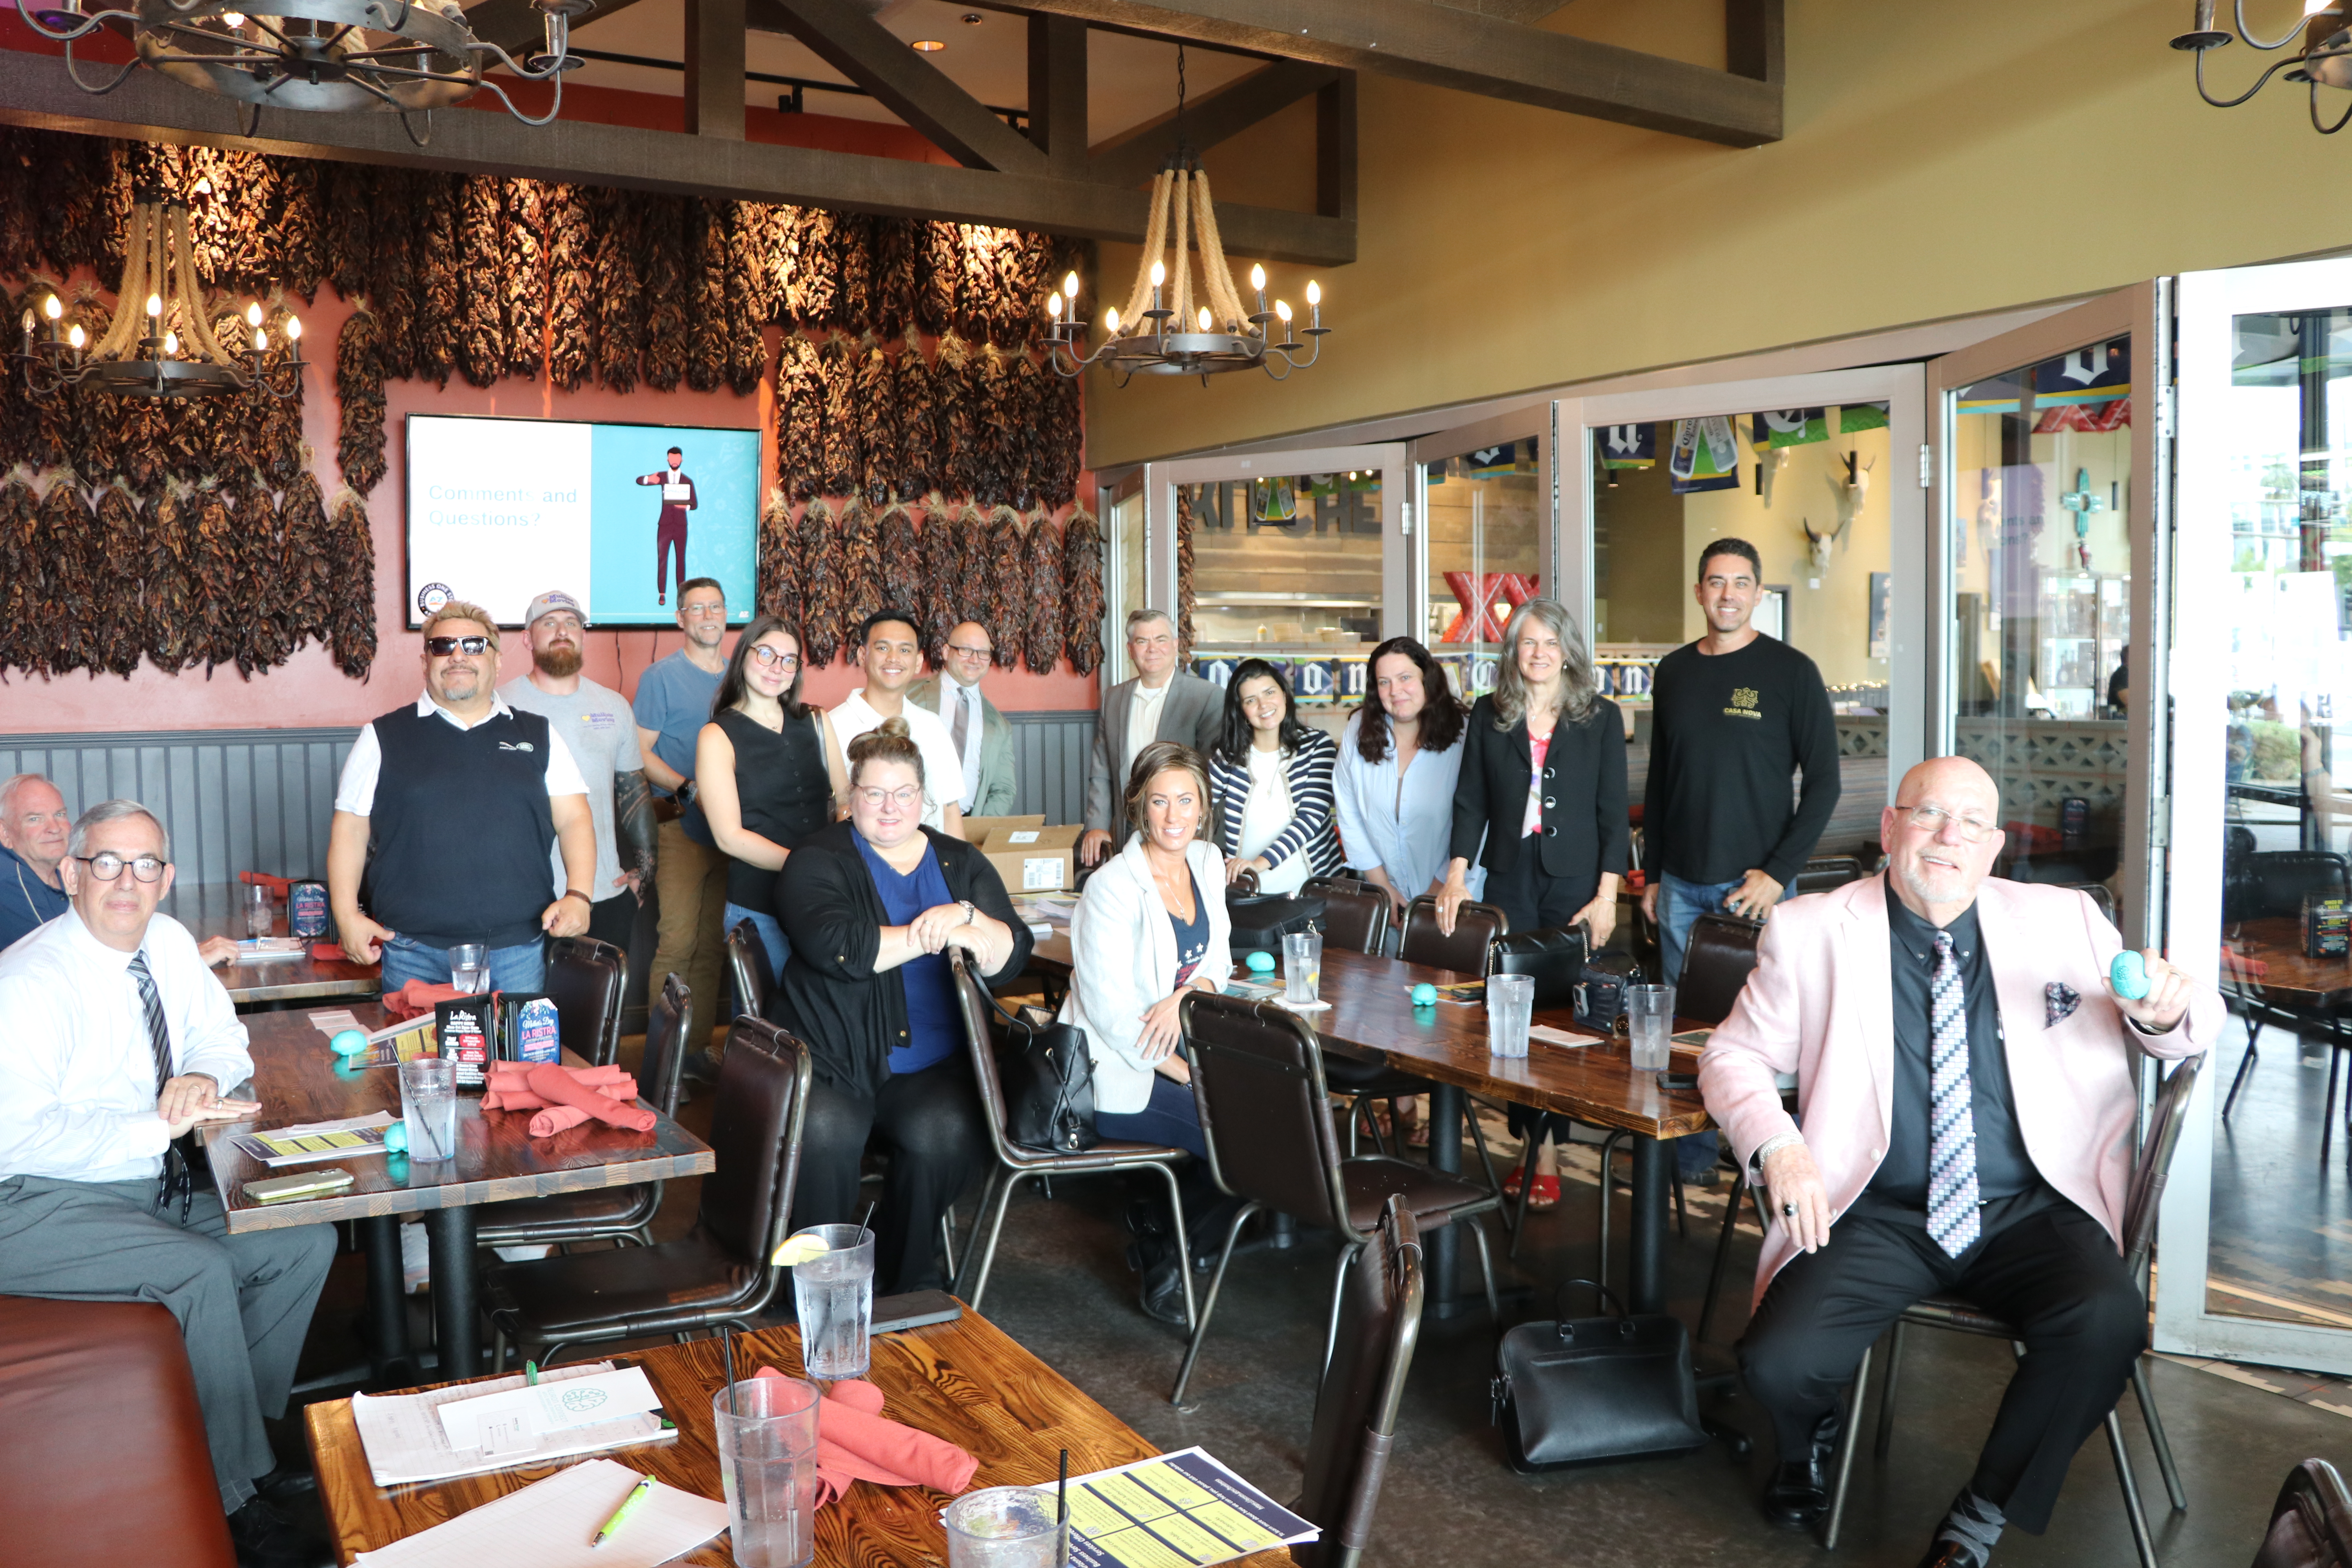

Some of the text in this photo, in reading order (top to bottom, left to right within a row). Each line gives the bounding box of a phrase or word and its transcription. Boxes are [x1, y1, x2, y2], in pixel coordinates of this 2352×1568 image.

[429, 485, 577, 503] Comments and
[429, 510, 541, 526] Questions?
[419, 584, 436, 607] BUSINESS
[436, 584, 449, 593] ONE
[1743, 709, 1762, 718] NOVA
[450, 1010, 477, 1021] La Ristra
[543, 1016, 554, 1027] Day
[522, 1030, 531, 1040] LA
[532, 1026, 557, 1038] RISTRA
[554, 1404, 568, 1423] CONNECT
[1142, 1476, 1161, 1486] Services
[1194, 1480, 1212, 1489] please
[1099, 1480, 1147, 1510] Document Authentication
[1109, 1494, 1130, 1506] Apostilles
[1212, 1516, 1239, 1531] Trademarks
[1243, 1511, 1261, 1521] about
[1255, 1519, 1272, 1527] more
[1209, 1521, 1236, 1536] Tradenames
[1167, 1531, 1196, 1549] Notary Public
[1081, 1541, 1107, 1556] Services
[1076, 1551, 1102, 1567] Business
